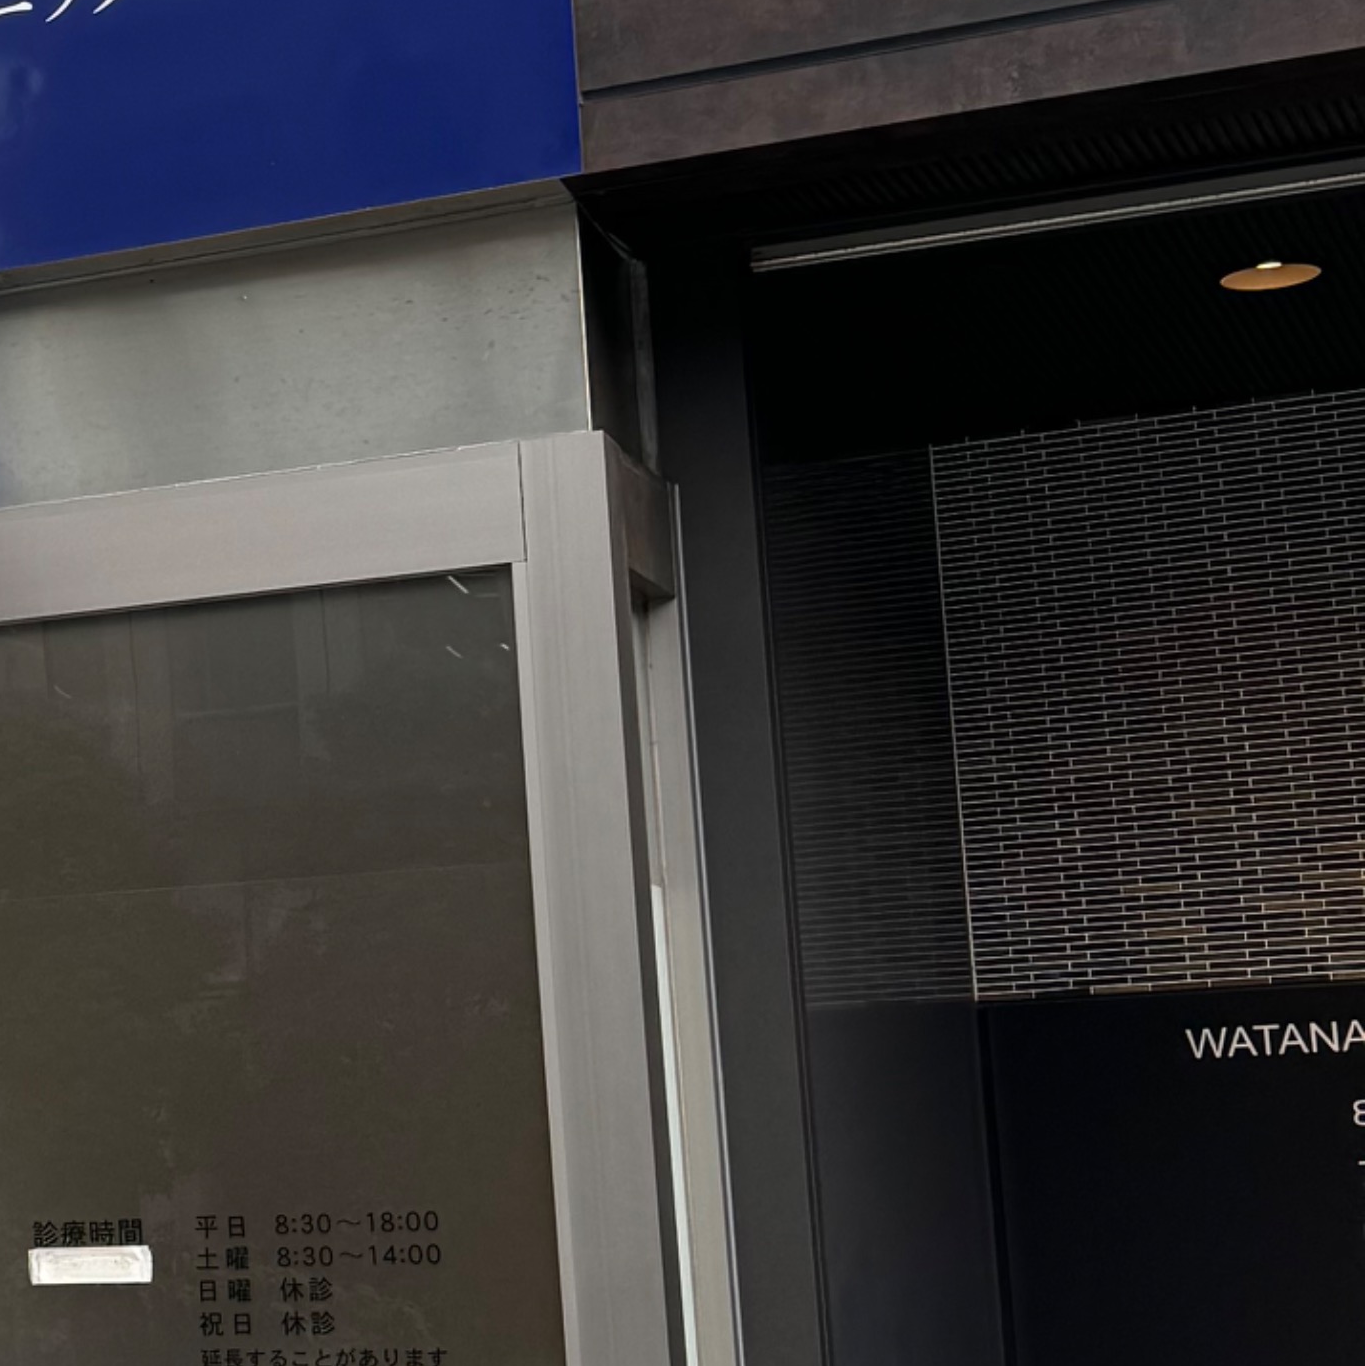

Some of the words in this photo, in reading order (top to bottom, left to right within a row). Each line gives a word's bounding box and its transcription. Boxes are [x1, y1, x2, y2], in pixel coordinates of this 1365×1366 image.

[33, 1218, 144, 1247] 診療時間
[195, 1215, 247, 1239] 平日
[196, 1247, 250, 1271] 土曜
[199, 1278, 252, 1303] 日曜
[280, 1277, 333, 1302] 休診
[199, 1312, 252, 1337] 祝日
[281, 1311, 335, 1335] 休診
